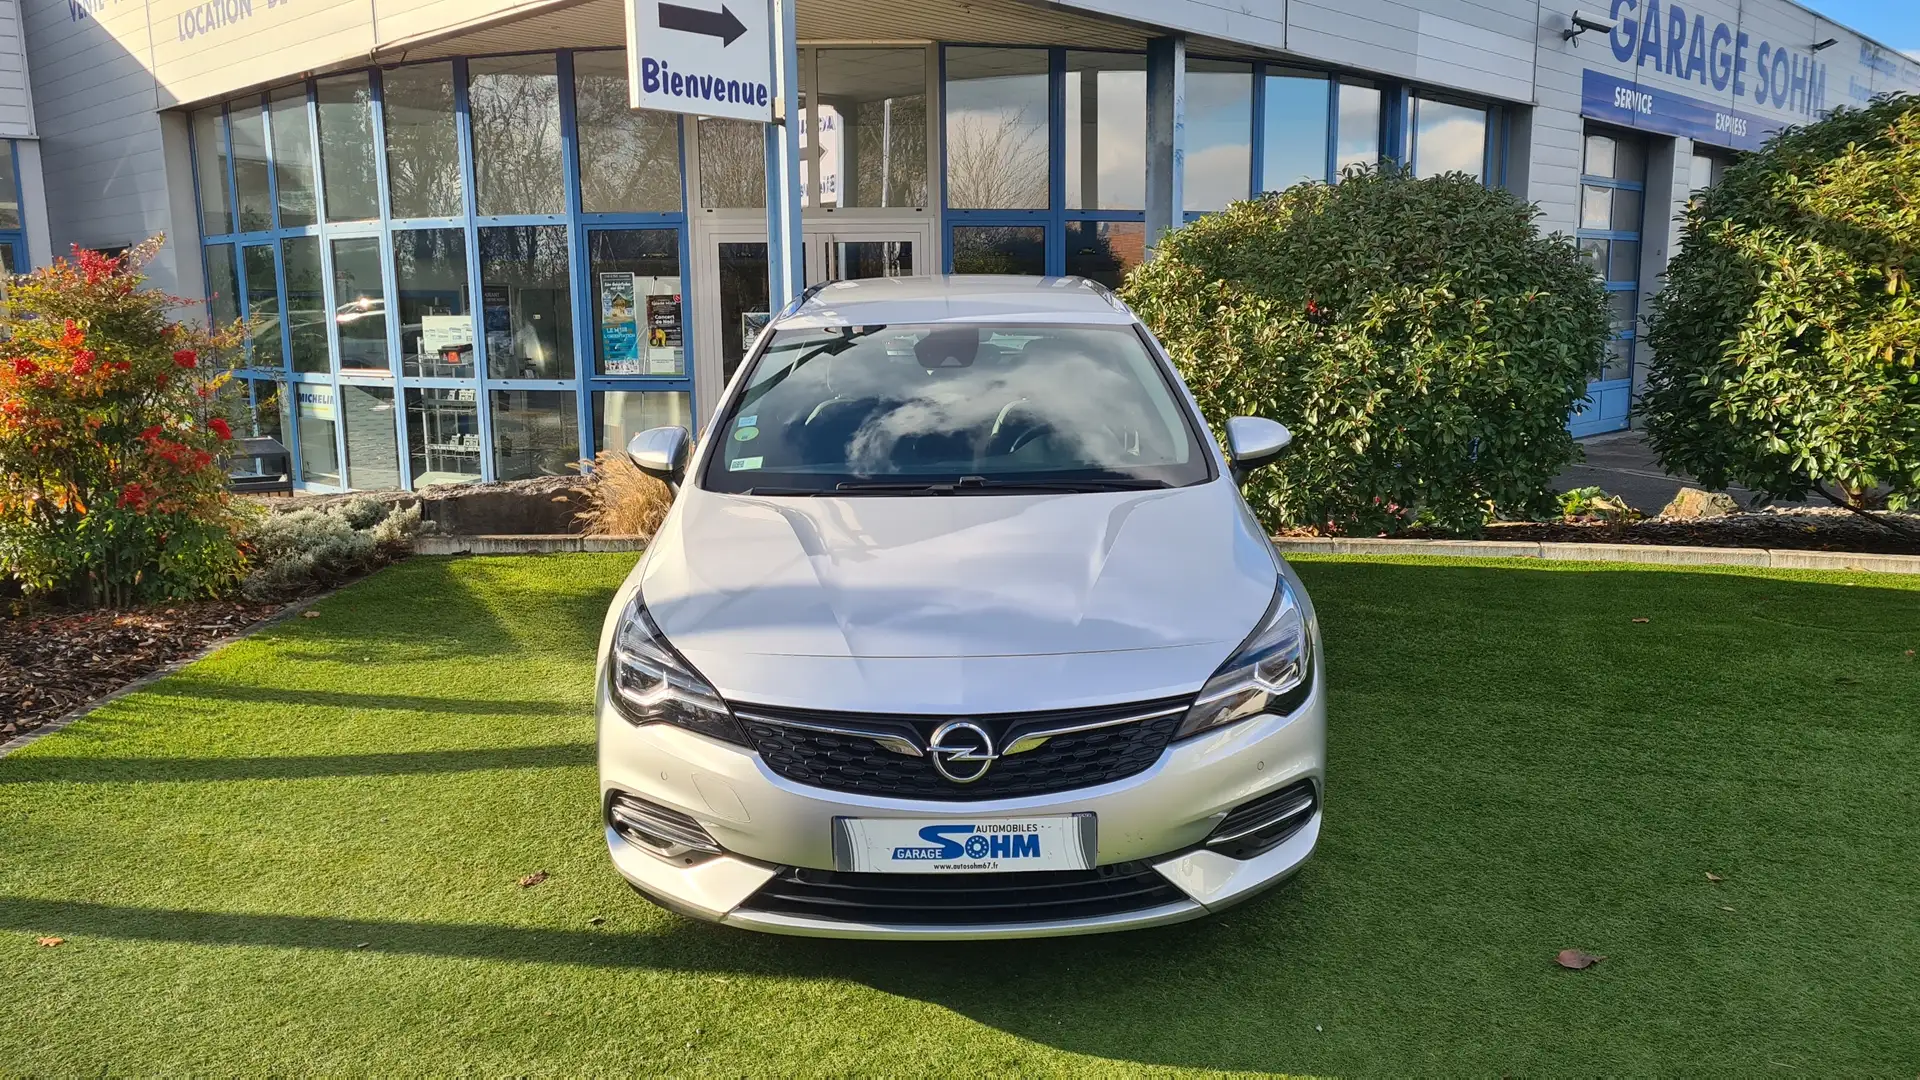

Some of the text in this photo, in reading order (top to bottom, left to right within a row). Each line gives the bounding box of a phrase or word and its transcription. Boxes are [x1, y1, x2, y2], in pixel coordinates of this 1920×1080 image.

[177, 0, 252, 41] LOCATION
[1609, 0, 1749, 97] GARAGE
[1754, 40, 1827, 121] SOHM
[641, 57, 768, 107] Bienvenue
[1614, 86, 1653, 115] SERVICE
[1715, 112, 1747, 137] EXPRESS
[975, 823, 1038, 833] AUTOMOBILES
[897, 849, 942, 859] GARAGE
[933, 862, 999, 870] www.autosohm67.fr
